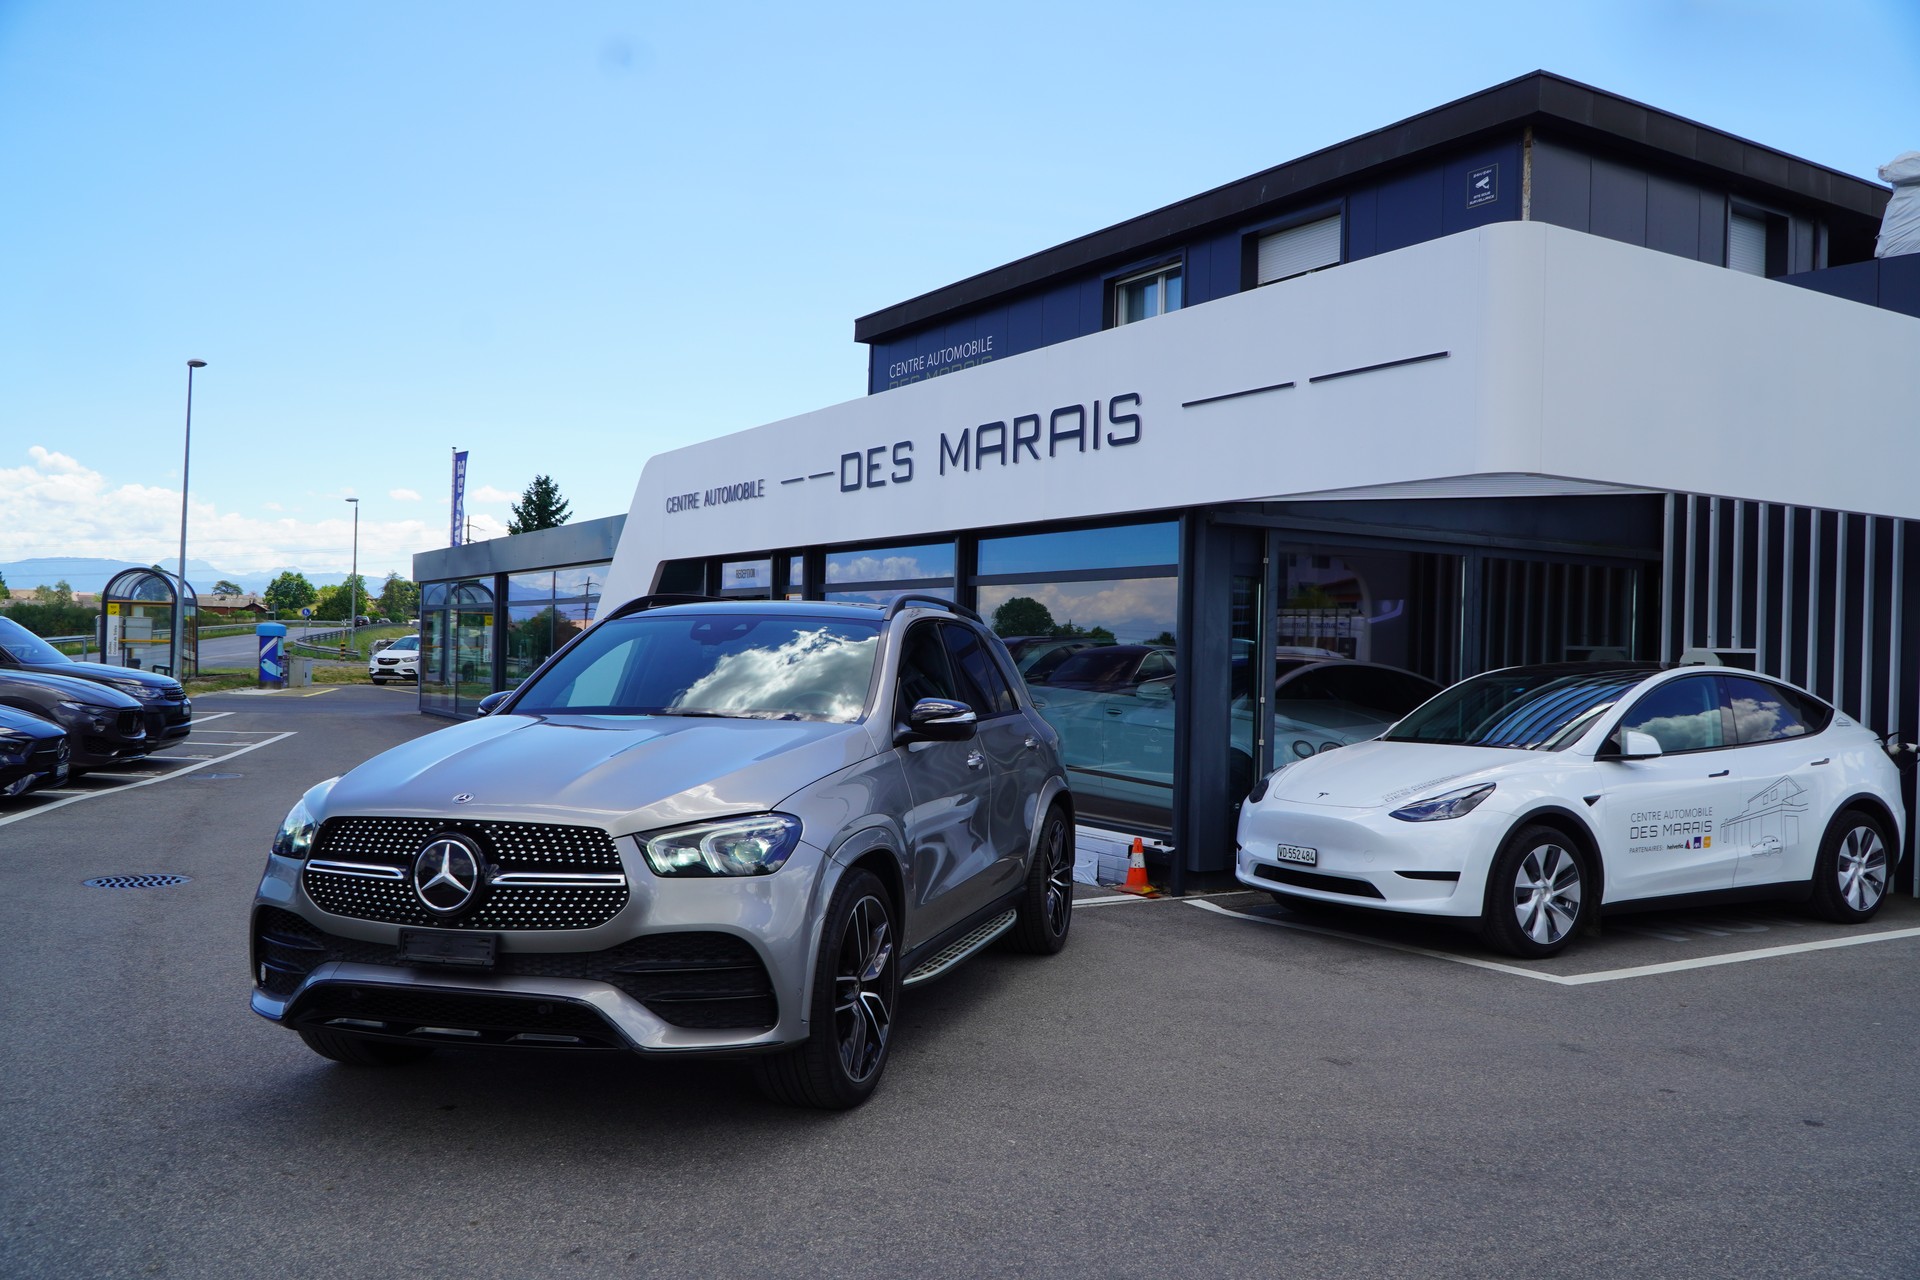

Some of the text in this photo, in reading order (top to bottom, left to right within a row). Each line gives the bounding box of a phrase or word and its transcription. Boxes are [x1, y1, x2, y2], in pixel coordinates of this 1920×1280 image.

[889, 355, 925, 379] CENTRE
[926, 335, 993, 368] AUTOMOBILE
[666, 392, 1143, 514] CENTRE AUTOMOBILE DES MARAIS
[1630, 806, 1713, 823] CENTRE AUTOMOBILE
[1630, 820, 1713, 840] DES MARAIS
